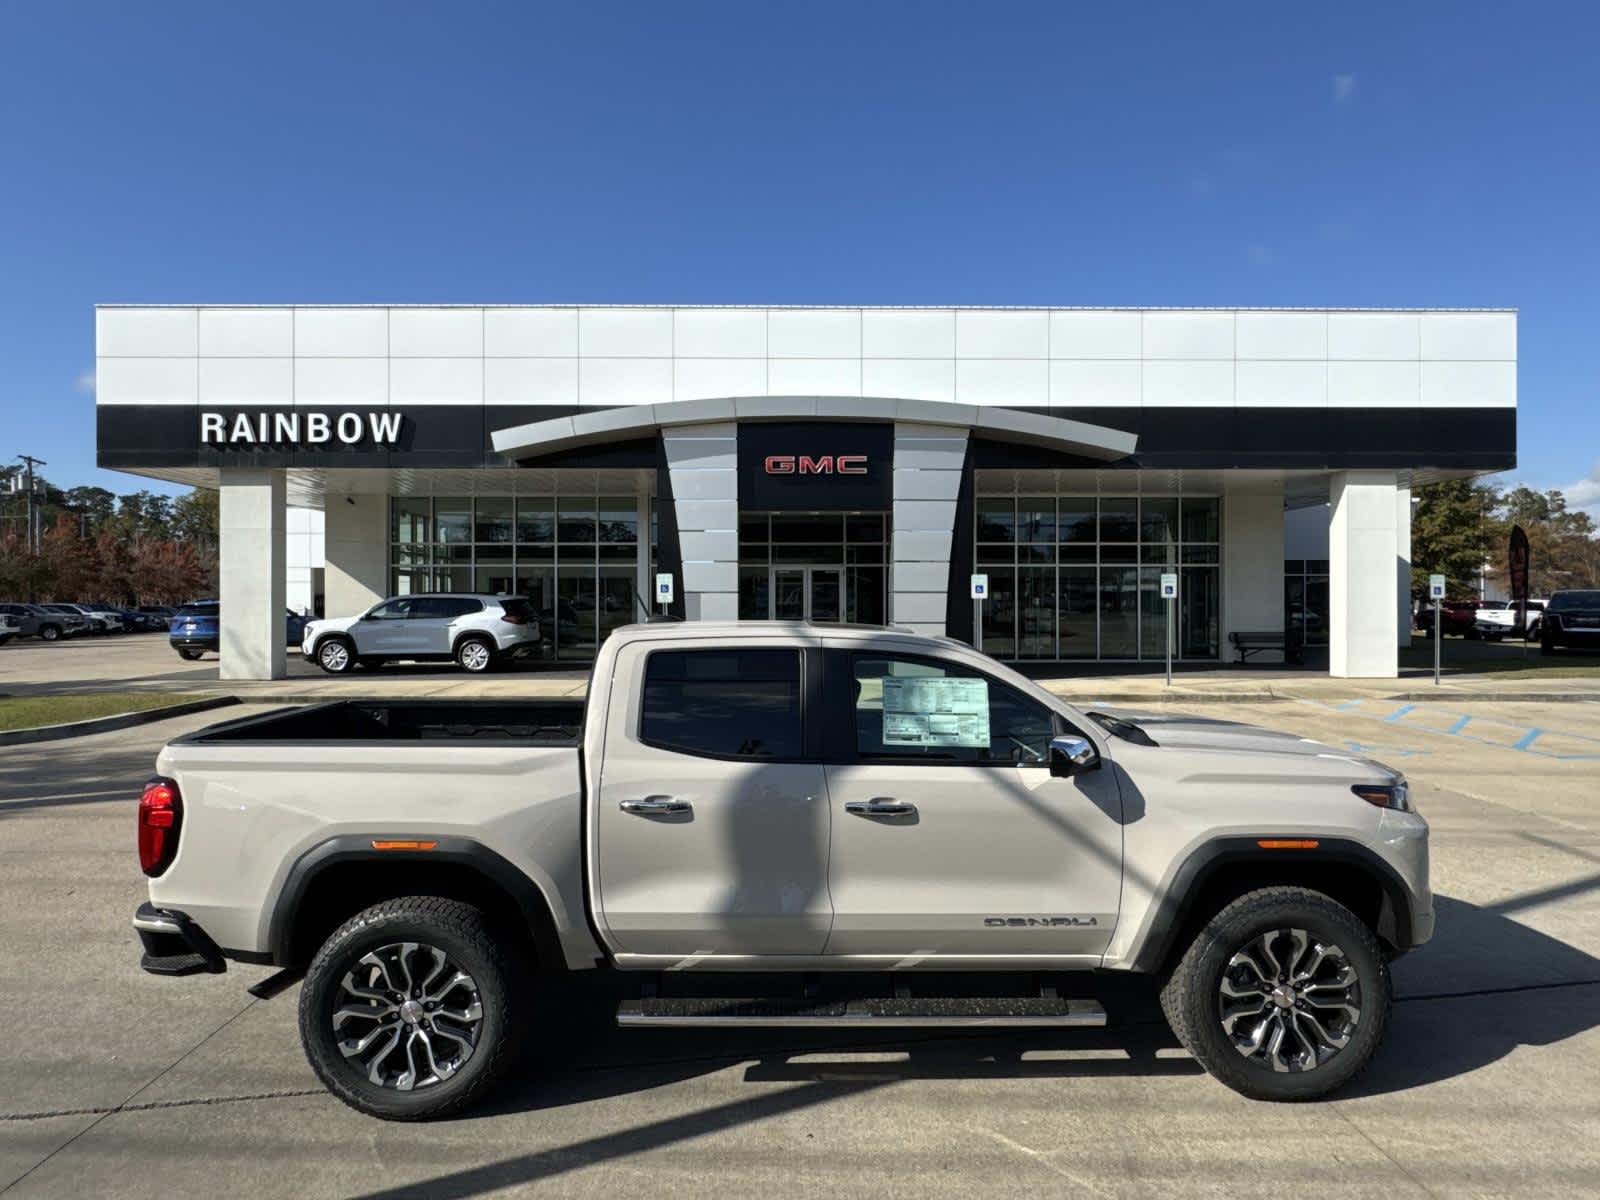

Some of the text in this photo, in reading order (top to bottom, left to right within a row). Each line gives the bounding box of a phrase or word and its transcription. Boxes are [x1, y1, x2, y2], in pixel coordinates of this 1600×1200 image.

[201, 412, 401, 444] RAINBOW
[765, 456, 868, 474] GMC
[984, 917, 1097, 927] DENALI
